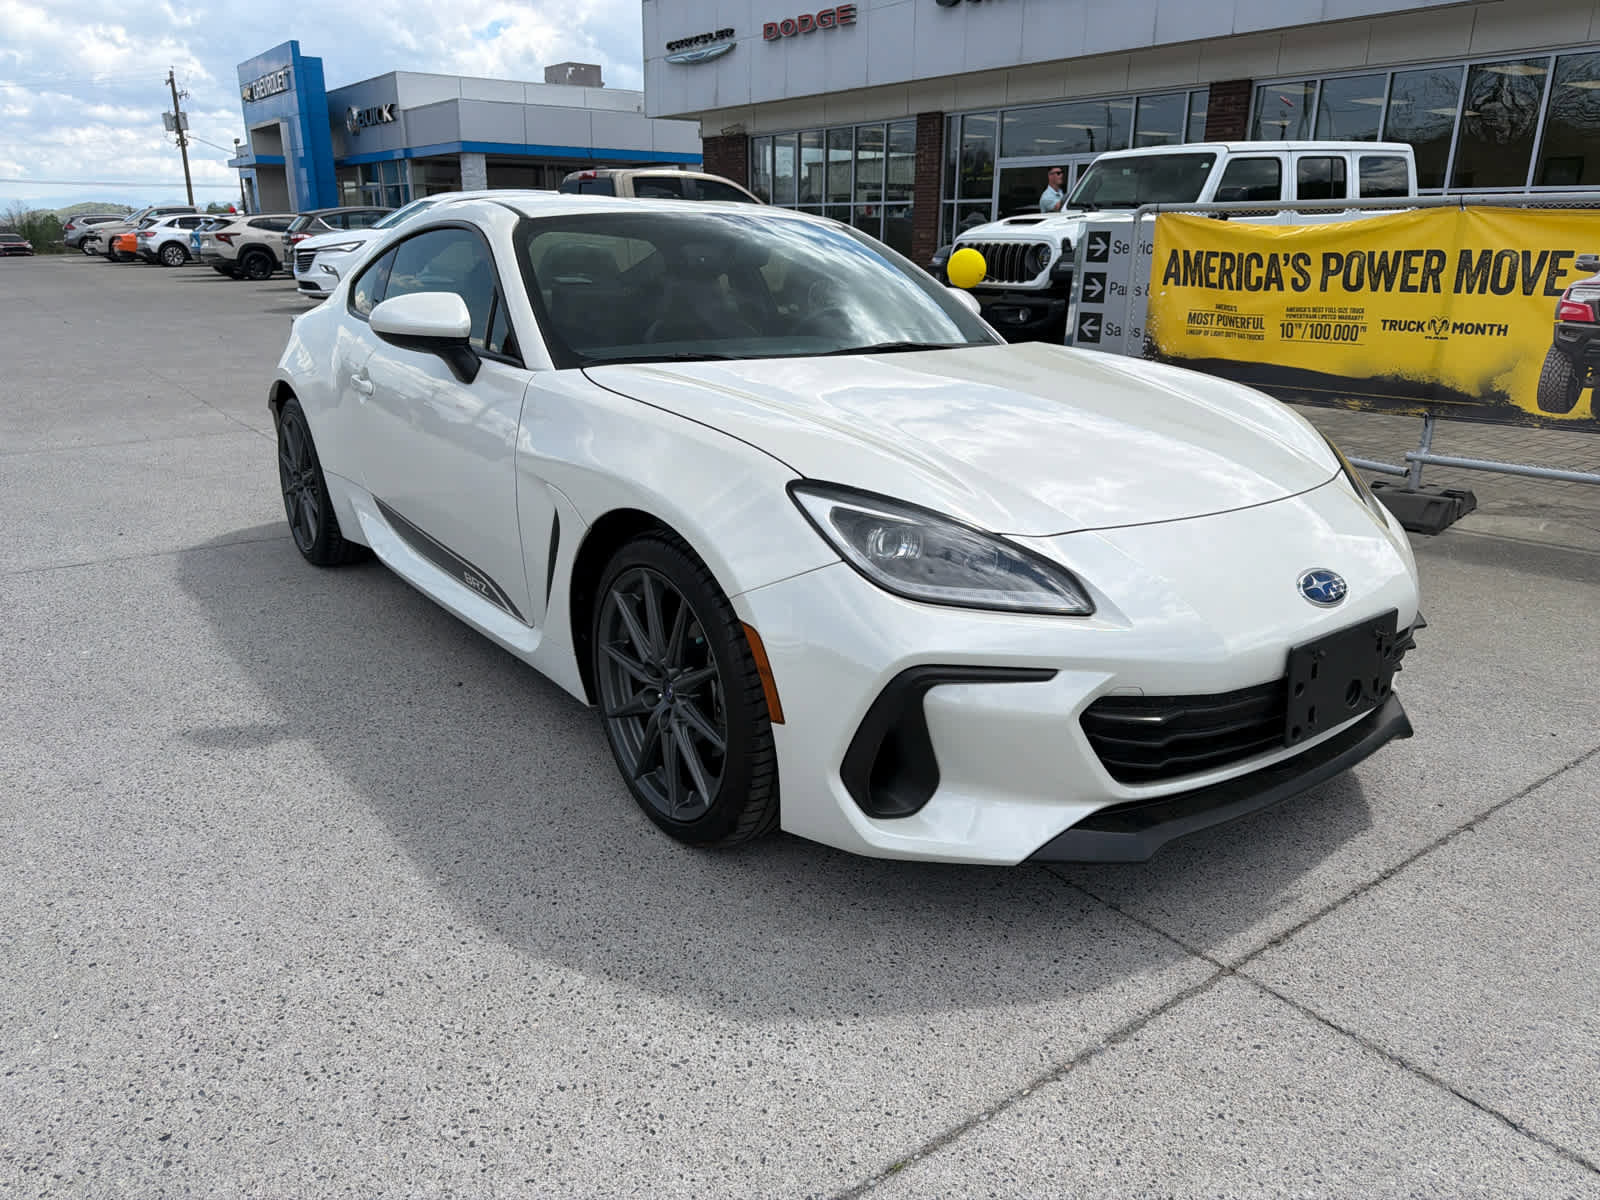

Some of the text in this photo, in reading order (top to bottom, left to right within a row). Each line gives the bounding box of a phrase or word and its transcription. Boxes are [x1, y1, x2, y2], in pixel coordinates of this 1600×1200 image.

[763, 4, 856, 41] DODGE
[252, 70, 289, 100] CHEVROLET
[358, 103, 395, 128] BUICK
[1162, 249, 1575, 297] AMERICA'S POWER MOVE
[1187, 312, 1265, 330] MOST POWERFUL
[1381, 319, 1509, 337] TRUCK MONTH
